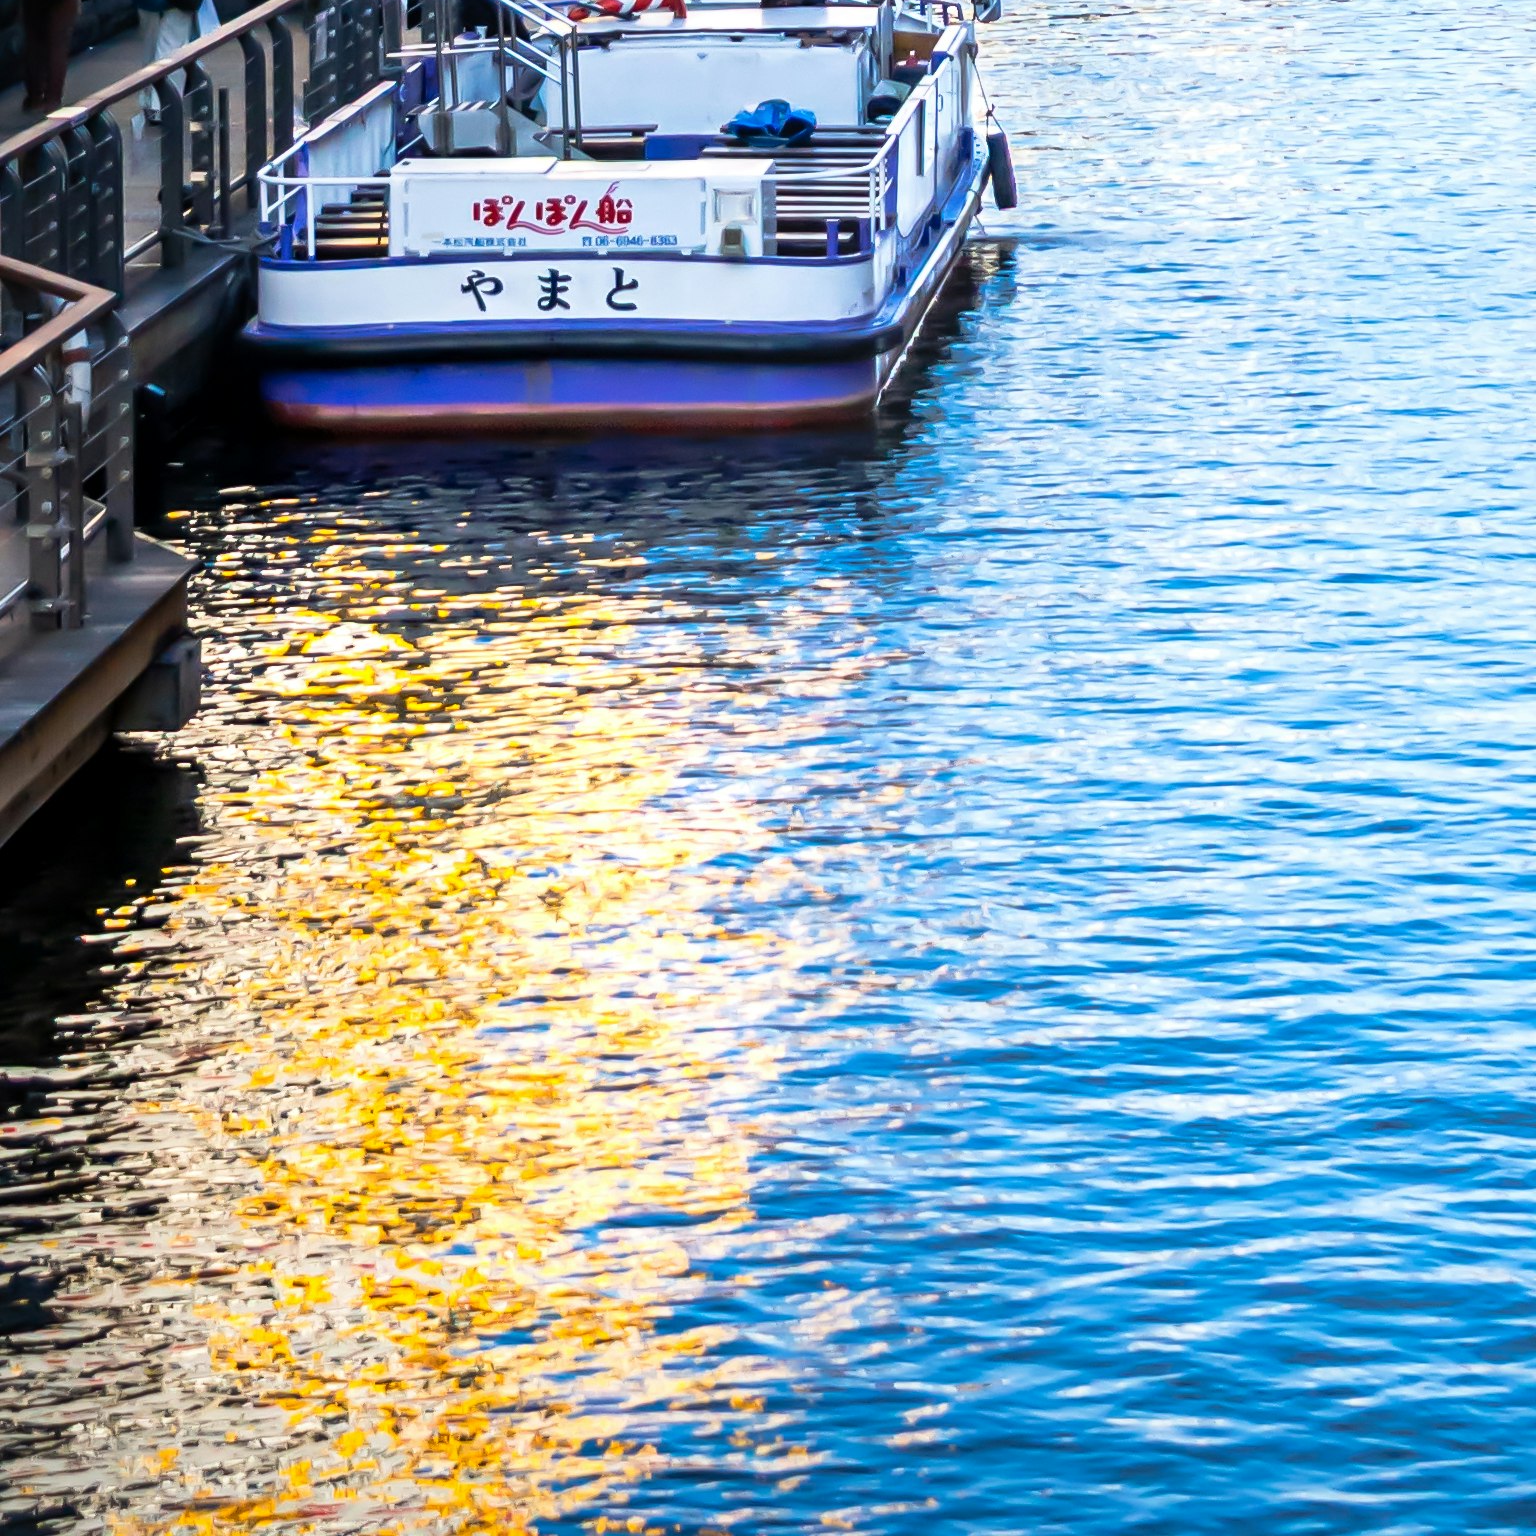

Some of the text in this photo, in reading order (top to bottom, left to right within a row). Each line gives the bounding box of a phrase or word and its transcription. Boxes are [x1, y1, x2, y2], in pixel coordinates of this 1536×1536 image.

[473, 191, 633, 235] ぽんぽん船
[461, 268, 639, 312] やまと
